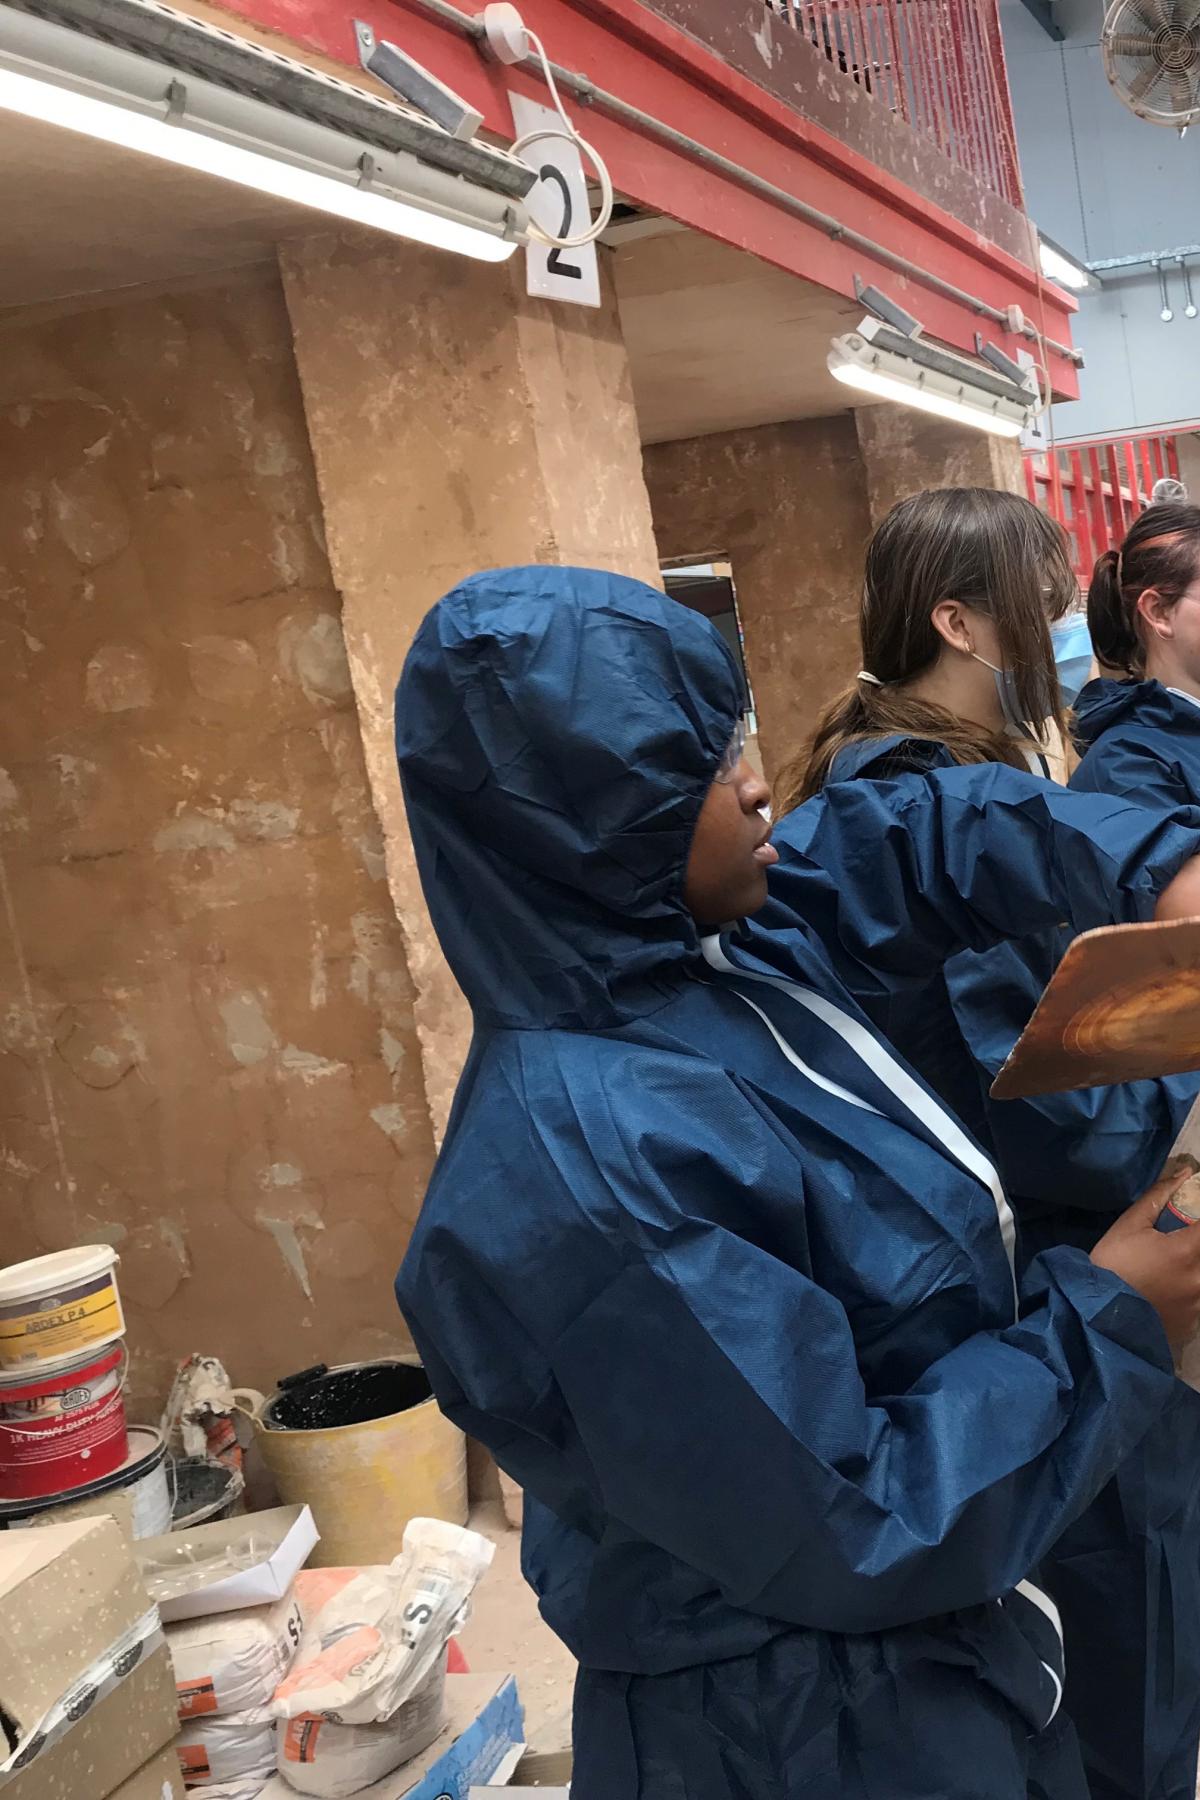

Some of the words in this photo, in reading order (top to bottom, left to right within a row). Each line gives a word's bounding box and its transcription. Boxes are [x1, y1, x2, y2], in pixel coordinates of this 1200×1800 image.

[539, 163, 582, 280] 2
[25, 1315, 65, 1334] ARDEX
[79, 1307, 86, 1317] 4
